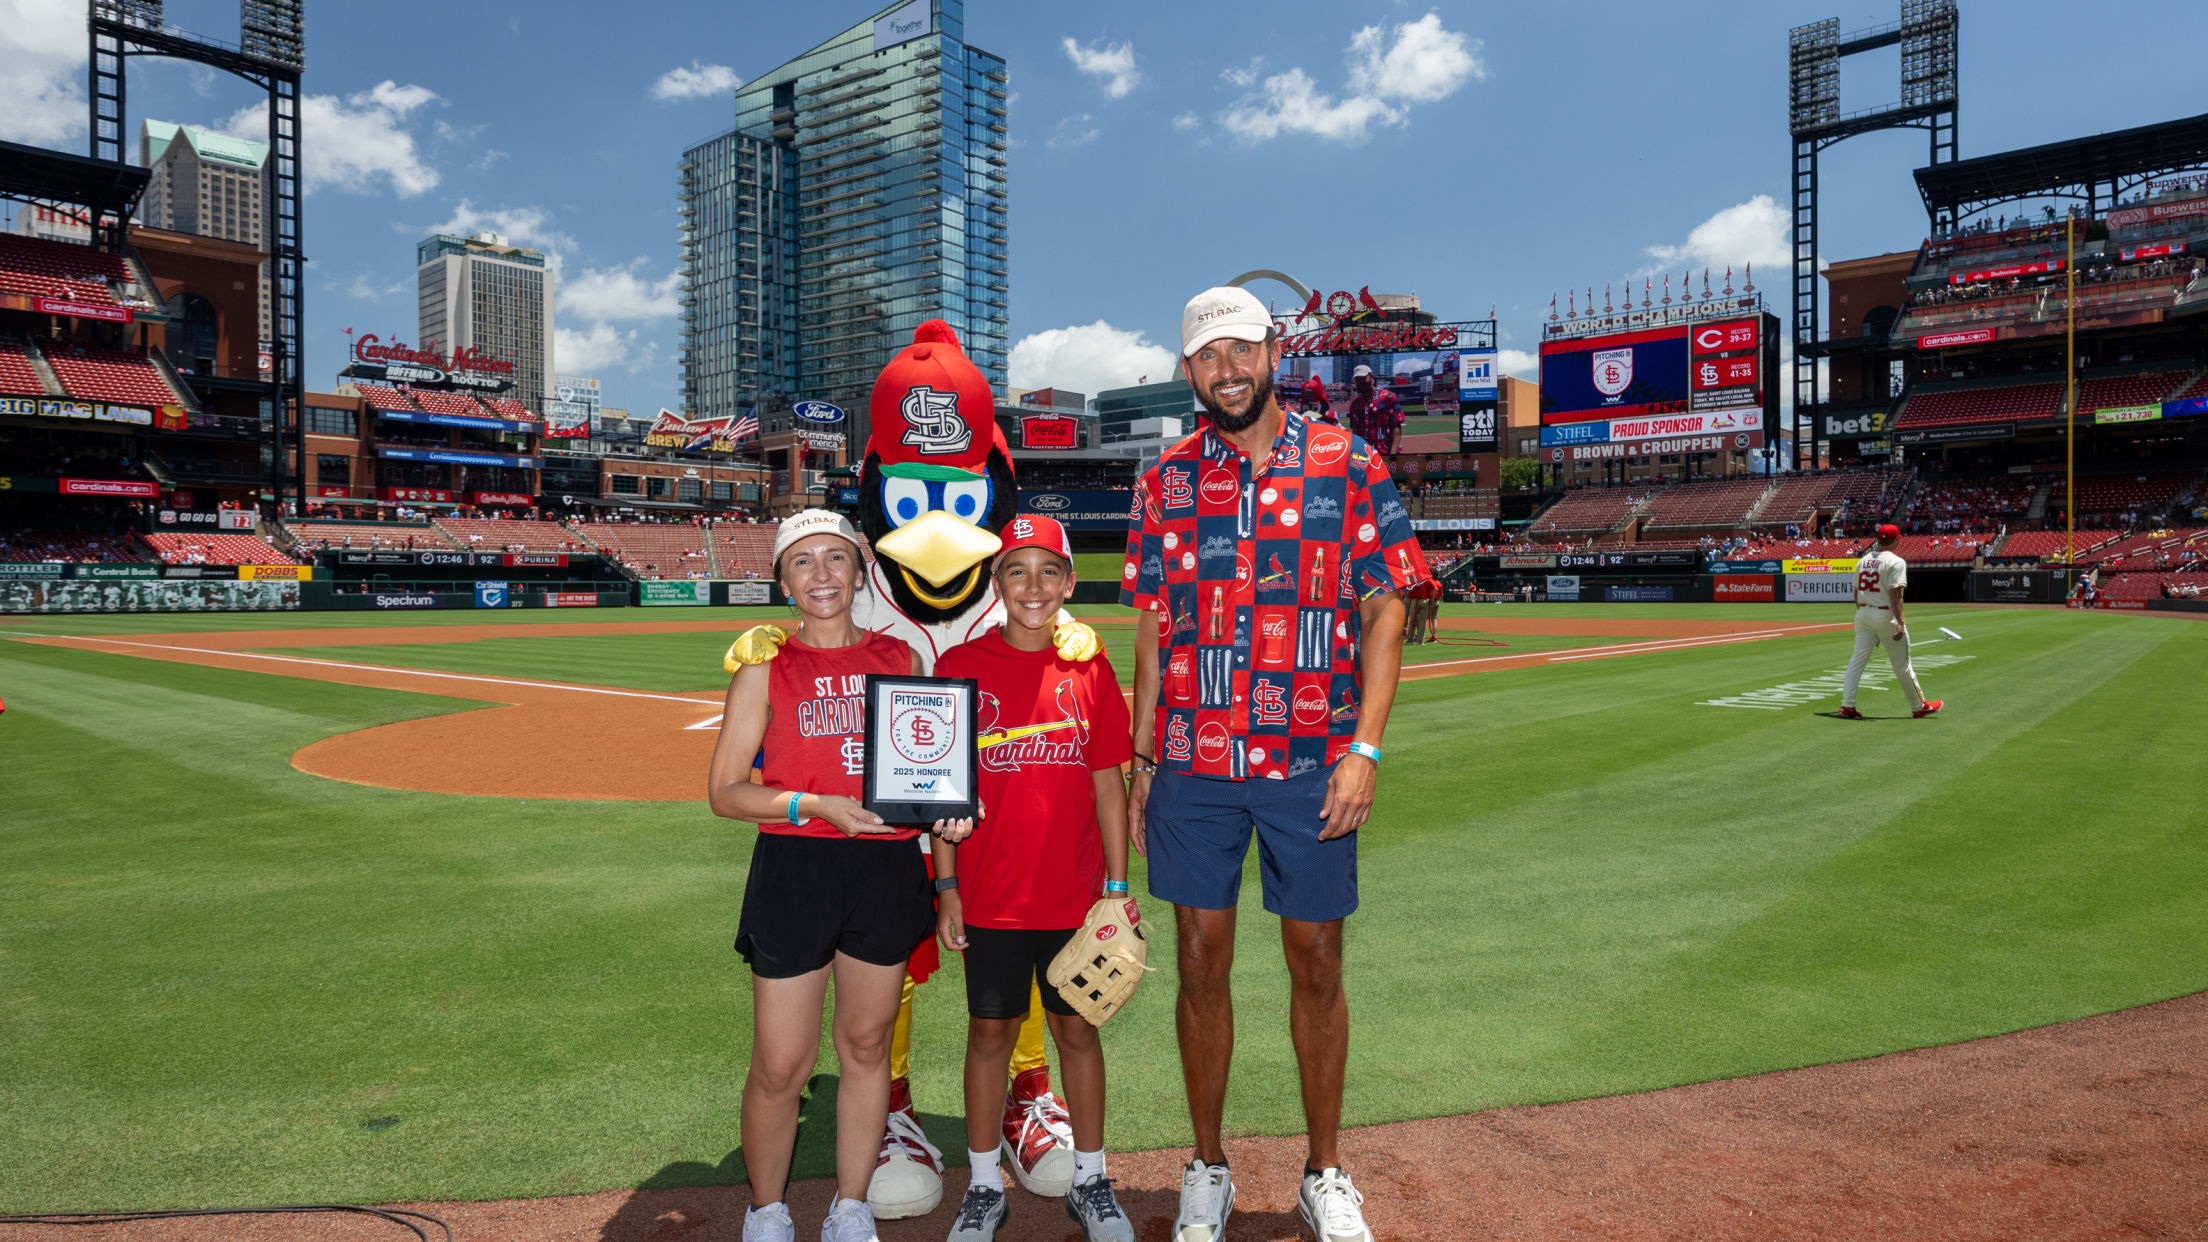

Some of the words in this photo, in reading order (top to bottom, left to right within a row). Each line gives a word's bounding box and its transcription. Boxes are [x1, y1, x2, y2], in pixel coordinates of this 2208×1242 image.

[44, 304, 122, 317] cardinals.com
[1198, 305, 1241, 323] STLBAC
[1561, 315, 1625, 335] WORLD
[1628, 299, 1739, 325] CHAMPIONS
[1730, 327, 1750, 335] RECORD
[1272, 320, 1458, 354] udweiser
[1730, 333, 1752, 343] 39-37
[1926, 334, 1987, 345] cardinals.com
[356, 333, 443, 366] Cardinals
[444, 345, 514, 375] Nation
[1595, 350, 1625, 361] PITCHING
[386, 364, 436, 381] HOFFMANN
[1730, 369, 1752, 378] 41-35
[452, 374, 500, 389] ROOFTOP
[38, 400, 93, 419] MAC
[94, 404, 152, 425] LAND
[805, 403, 836, 420] Ford
[651, 417, 730, 437] Budweer
[1613, 421, 1649, 438] PROUD
[1651, 417, 1702, 434] SPONSOR
[1556, 426, 1593, 440] STIFEL
[647, 433, 686, 448] BREW
[809, 440, 838, 449] merica
[1573, 444, 1624, 459] BROWN
[1628, 446, 1637, 455] &
[1641, 436, 1723, 455] CROUPPEN
[71, 483, 149, 492] cardinals.com
[1037, 497, 1063, 507] Ford
[180, 513, 191, 521] GO
[193, 513, 204, 522] GO
[205, 514, 216, 522] GO
[794, 517, 838, 530] STLBAC
[1437, 519, 1492, 530] LOUIS
[437, 554, 462, 564] 12:46
[1504, 556, 1550, 564] Schnucks
[1573, 557, 1594, 565] 12:46
[92, 568, 128, 576] Central
[131, 568, 158, 576] Bank
[255, 567, 298, 576] DOBBS
[476, 581, 507, 589] CarShield
[1859, 571, 1880, 592] 62
[1992, 579, 2010, 587] Mercy
[1612, 590, 1639, 600] STIFEL
[377, 595, 432, 607] Spectrum
[815, 677, 836, 697] ST.
[841, 675, 865, 696] LOU
[895, 695, 943, 706] PITCHING
[799, 697, 864, 737] CARDIN
[902, 745, 915, 756] THE
[918, 730, 951, 759] COMMUNITY
[894, 767, 915, 776] 2025
[917, 768, 952, 777] HONOREE
